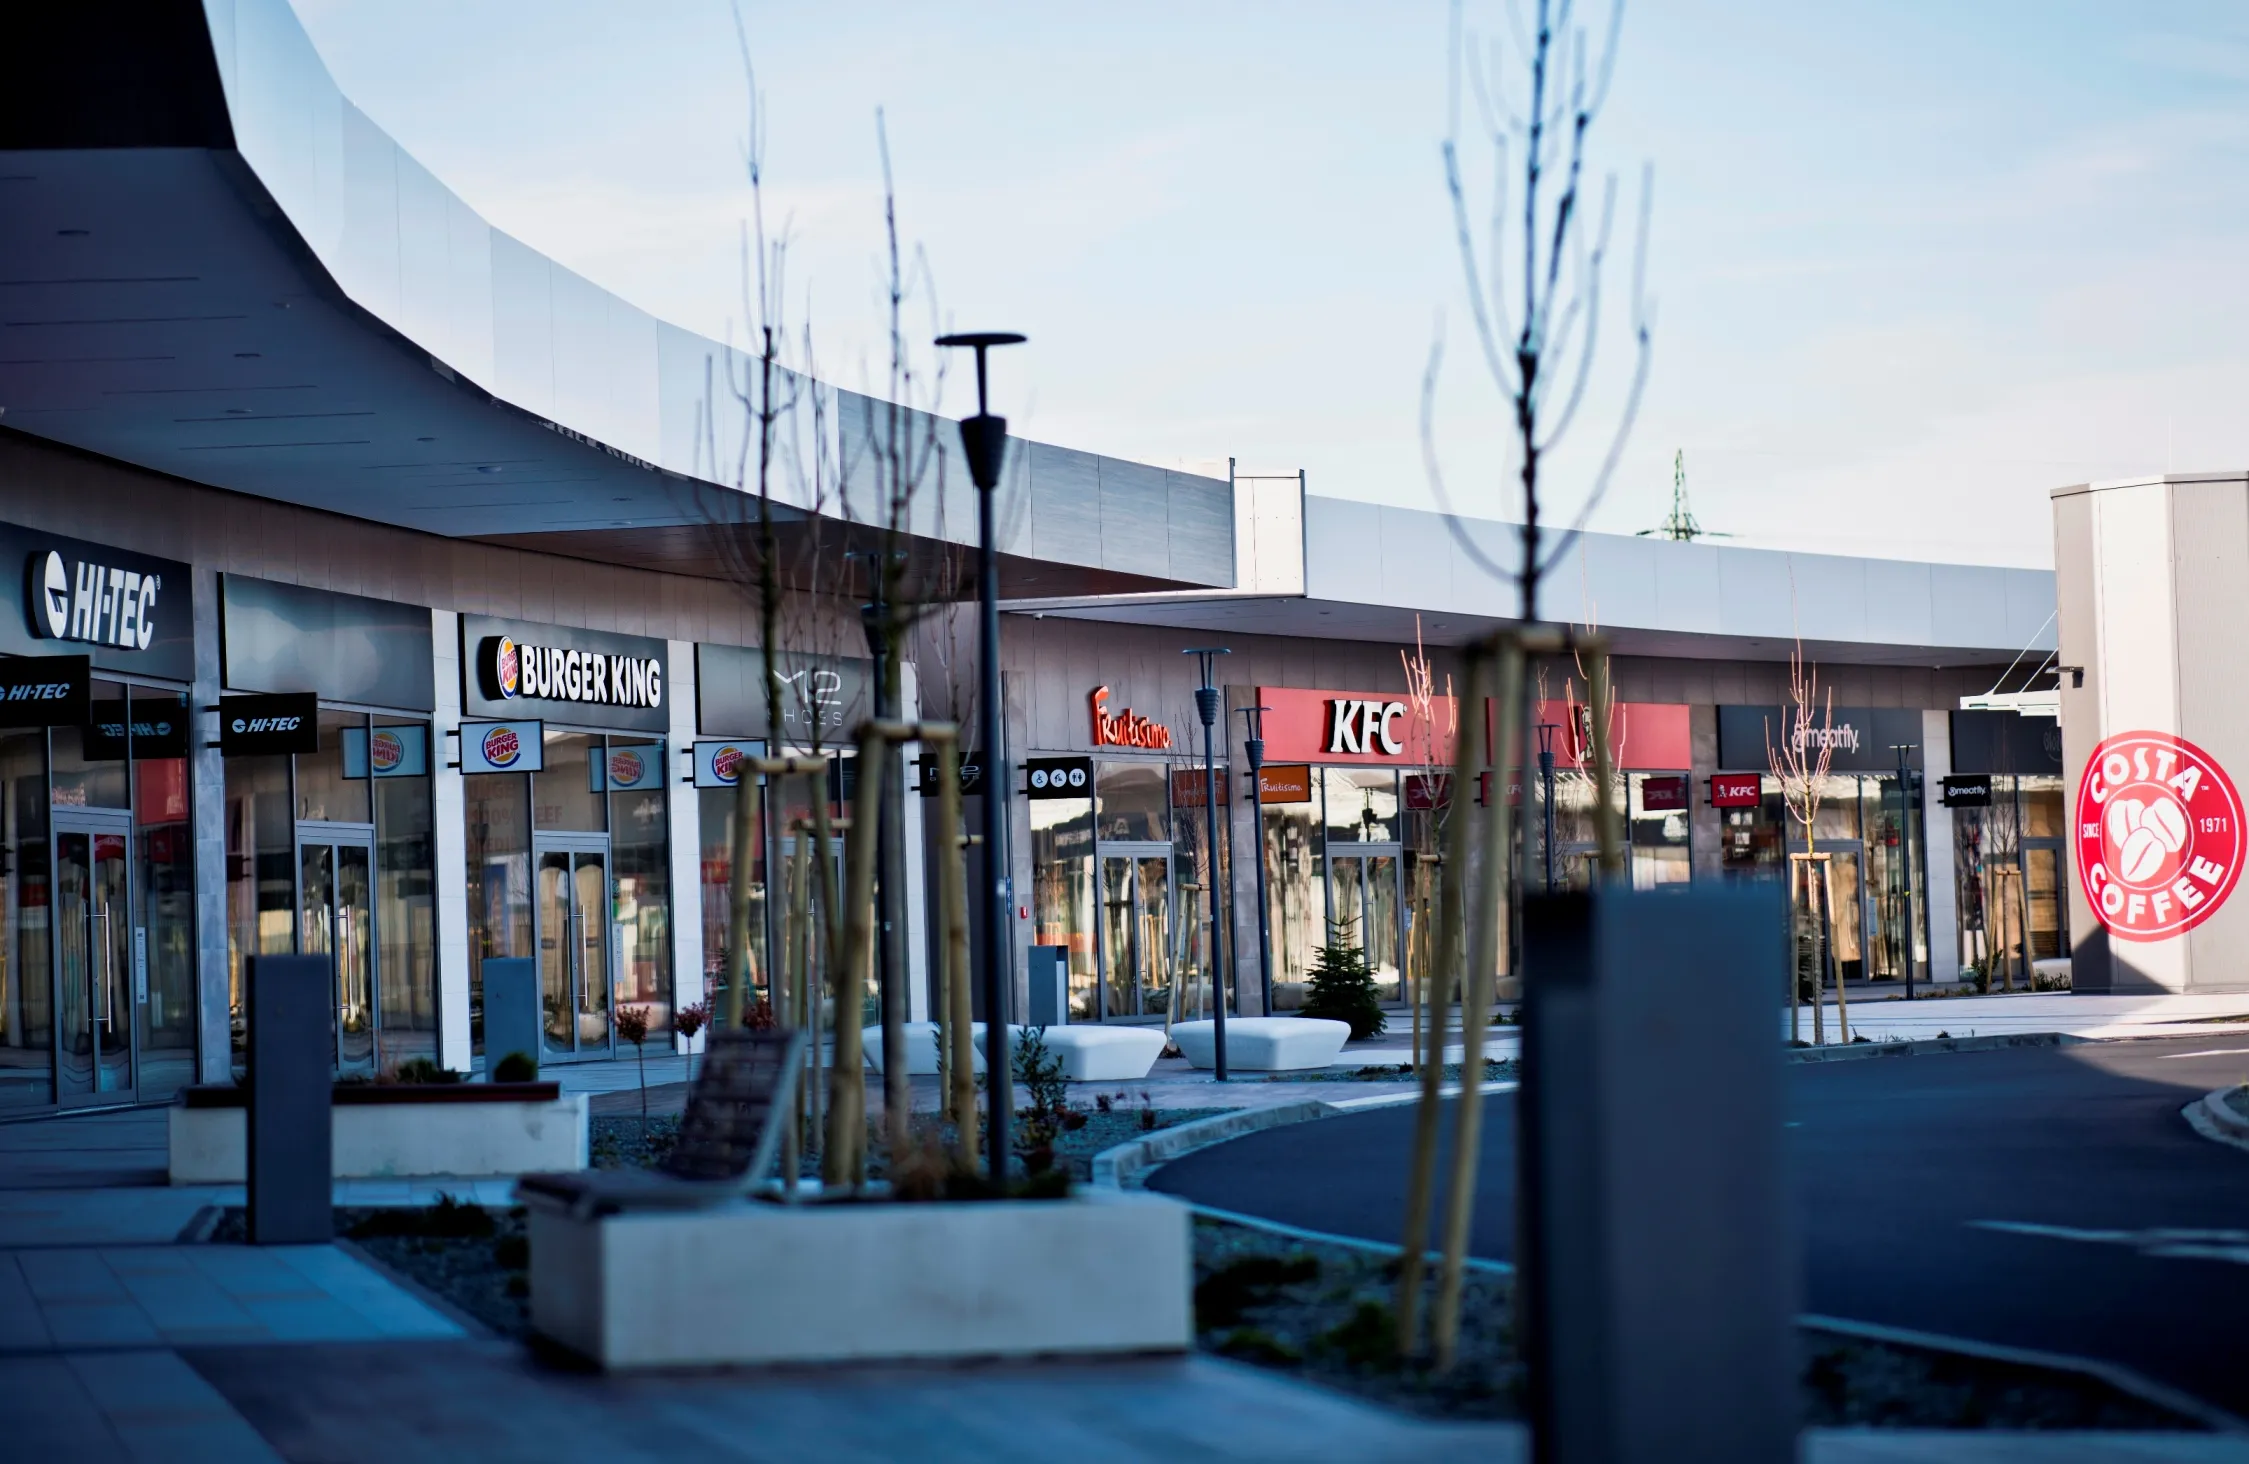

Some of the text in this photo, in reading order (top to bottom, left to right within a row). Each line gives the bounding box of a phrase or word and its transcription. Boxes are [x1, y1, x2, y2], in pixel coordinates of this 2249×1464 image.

[521, 644, 661, 708] BURGER KING
[7, 682, 70, 701] HI-TEC
[246, 715, 301, 733] HI-TEC
[1330, 699, 1406, 755] KFC
[485, 731, 517, 750] BURGER
[487, 741, 519, 762] KING
[715, 750, 744, 767] BURGER
[2090, 746, 2203, 805] COSTA
[1728, 785, 1757, 797] KFC
[2082, 817, 2228, 840] SINCE 1971
[2090, 855, 2225, 925] COFFEE
